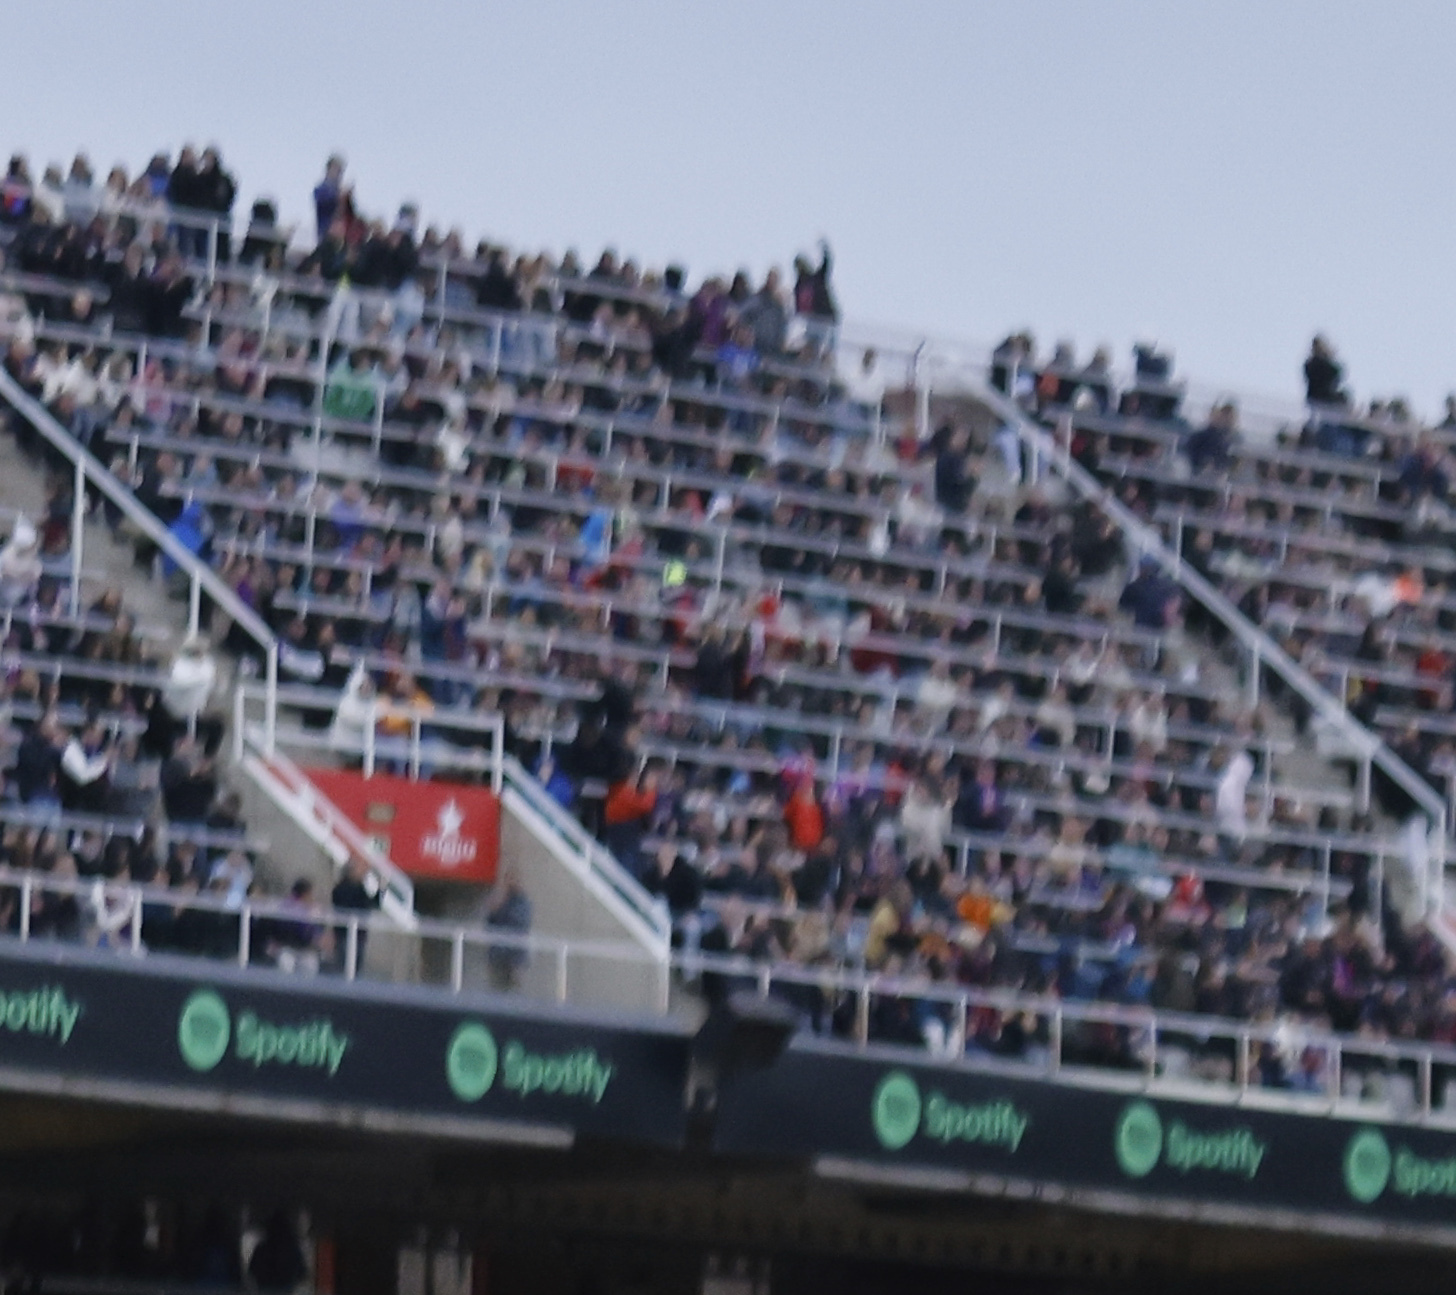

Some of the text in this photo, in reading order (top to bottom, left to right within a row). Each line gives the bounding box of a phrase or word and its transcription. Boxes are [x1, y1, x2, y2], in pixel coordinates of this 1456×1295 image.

[234, 1011, 349, 1076] Spotify
[502, 1041, 614, 1104] Spotify
[924, 1092, 1028, 1153] Spotify
[1166, 1121, 1266, 1180] Spotify
